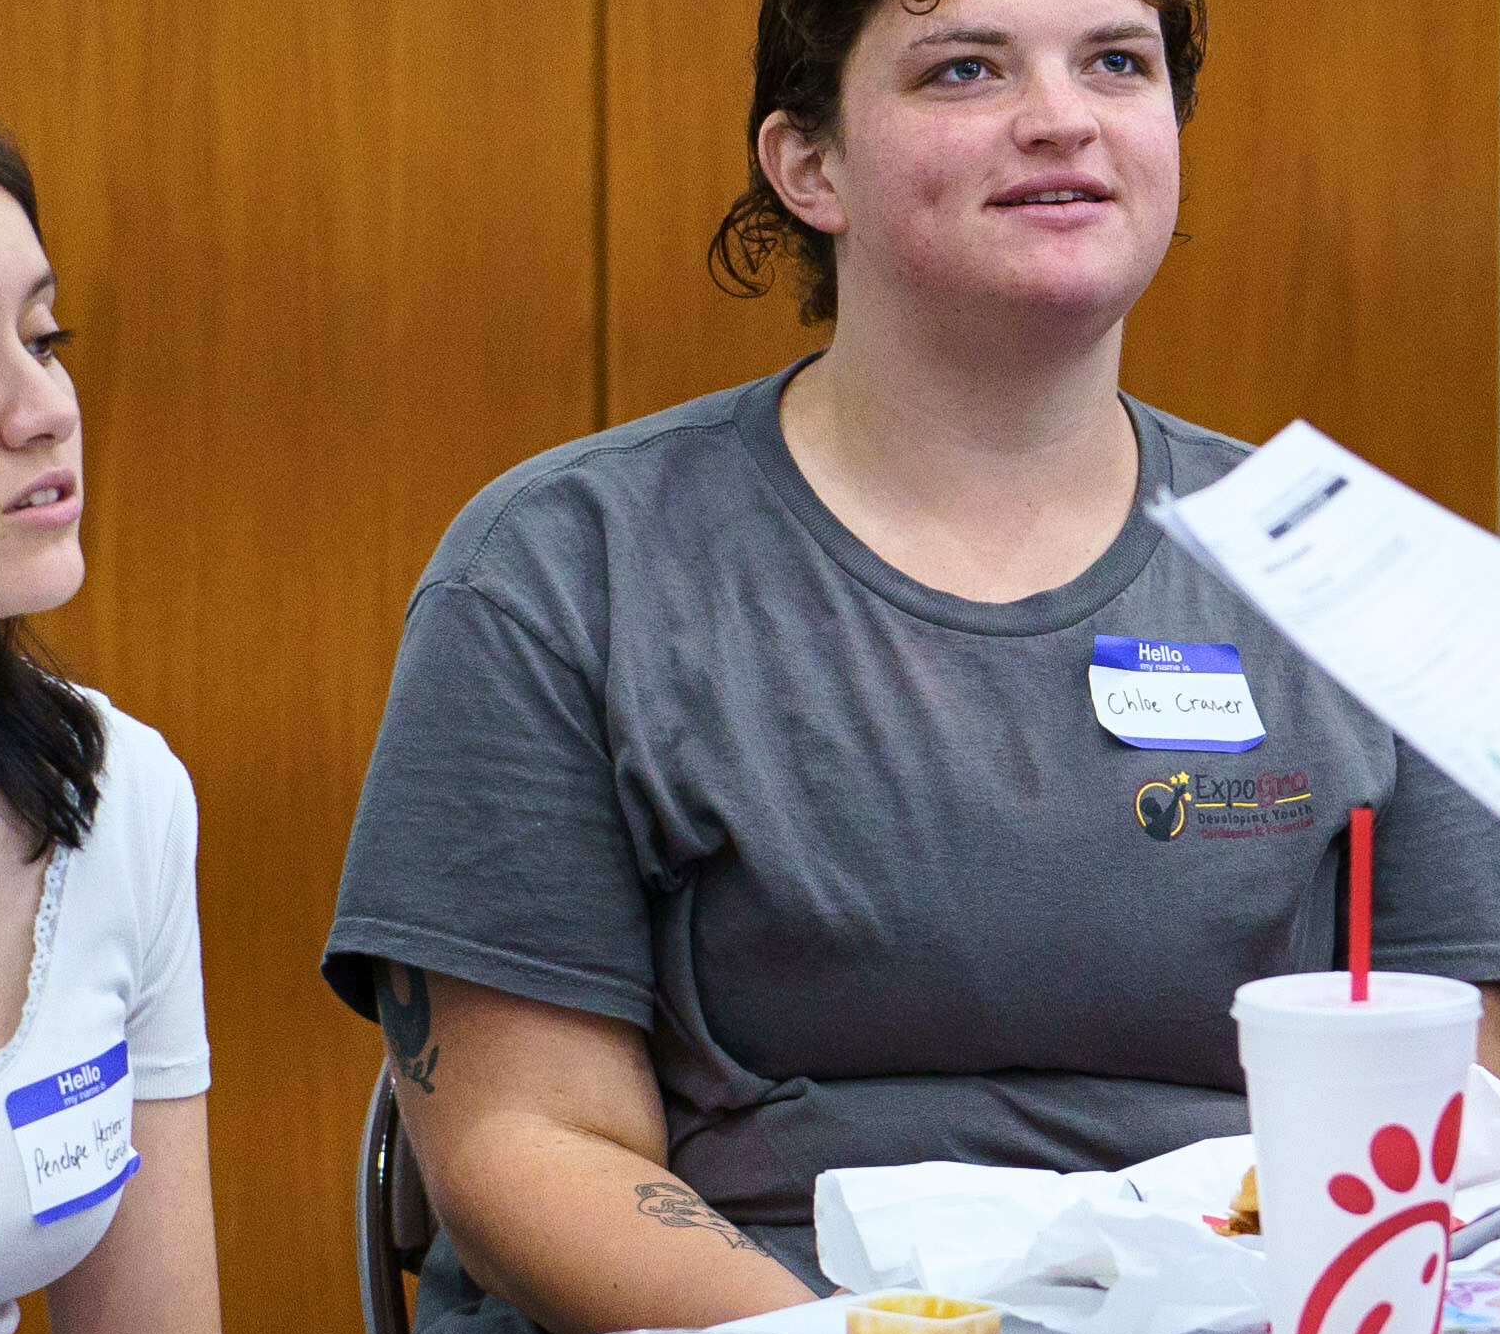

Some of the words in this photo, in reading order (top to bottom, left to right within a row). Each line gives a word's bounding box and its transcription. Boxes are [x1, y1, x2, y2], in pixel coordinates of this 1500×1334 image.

[1138, 642, 1183, 663] Hello
[1107, 688, 1161, 715] Chloe
[1195, 771, 1309, 809] ExpoGro
[1198, 808, 1269, 826] Developing
[1271, 803, 1314, 820] Youth
[57, 1064, 101, 1095] Hello
[33, 1142, 89, 1184] Penelope
